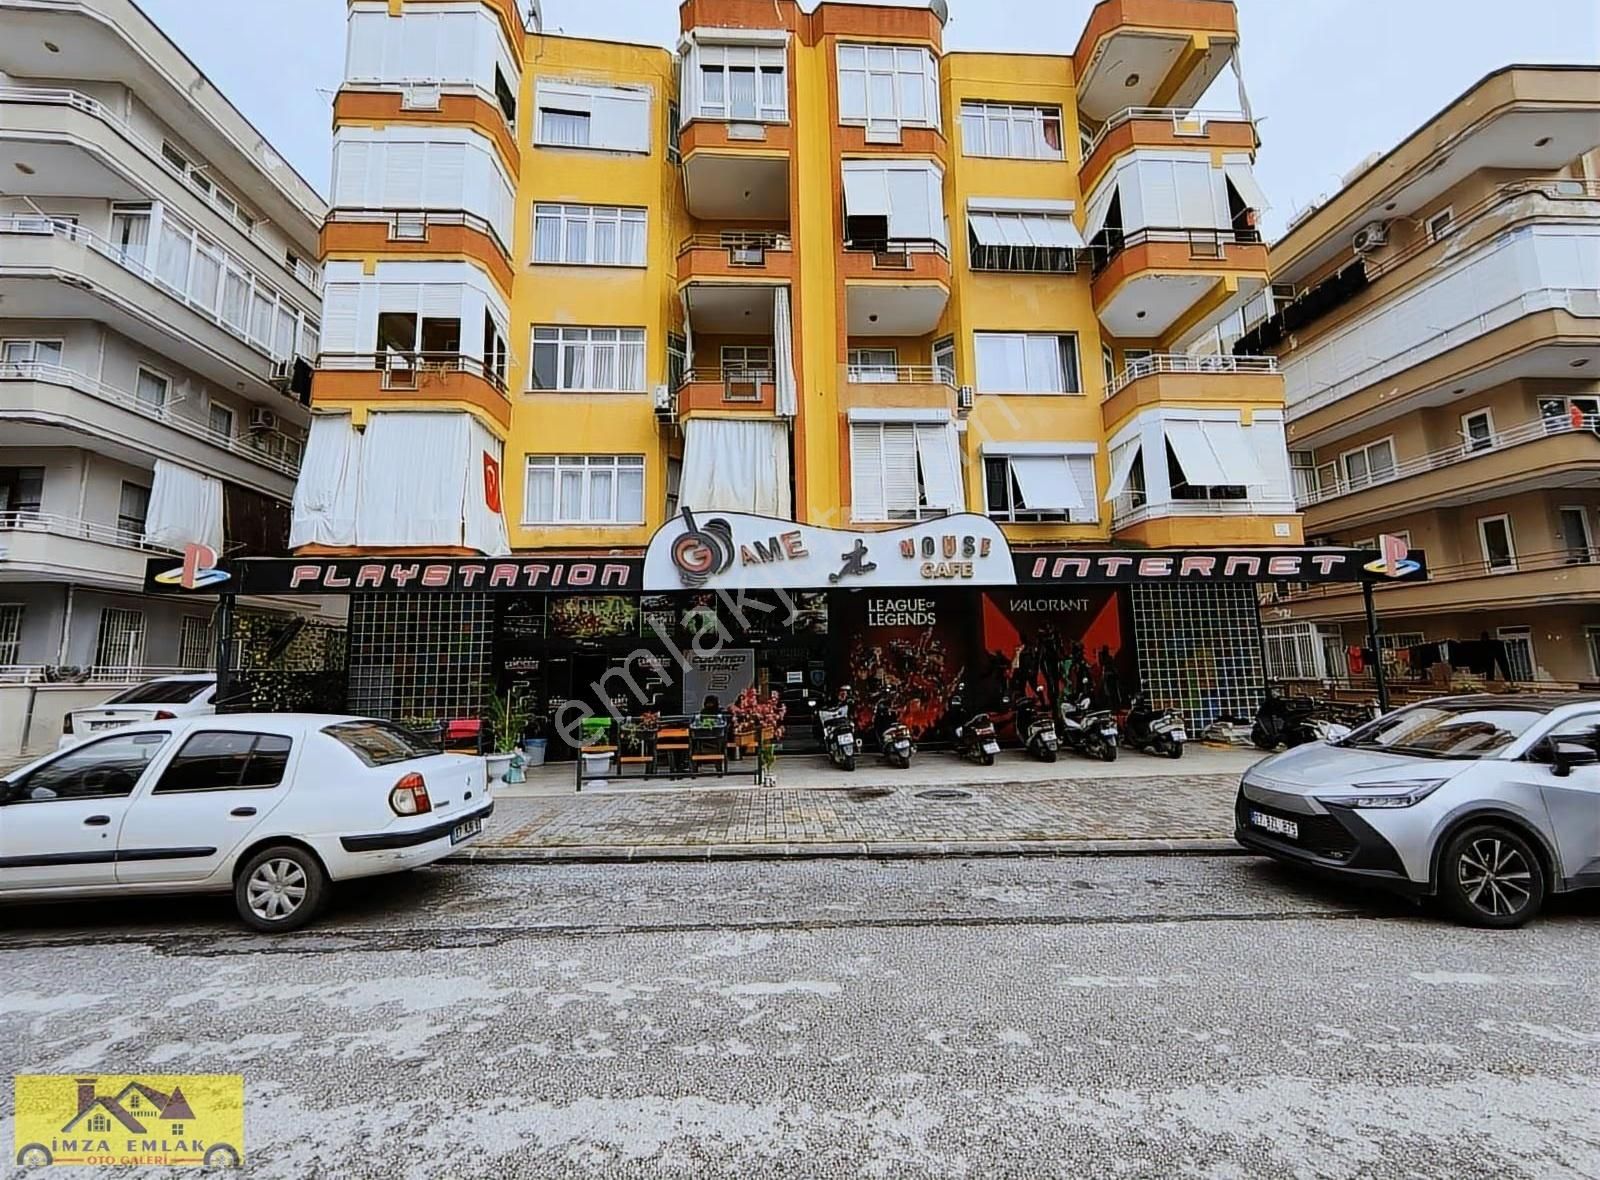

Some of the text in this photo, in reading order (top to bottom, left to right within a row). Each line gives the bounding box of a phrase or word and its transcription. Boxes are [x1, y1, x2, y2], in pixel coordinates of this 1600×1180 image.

[920, 561, 974, 579] CAFE
[1031, 555, 1346, 578] INTERNET
[289, 563, 631, 588] PLAYSTATION
[868, 599, 926, 612] LEAGUE
[1009, 599, 1089, 612] VALORANT
[868, 612, 936, 626] LEGENDS
